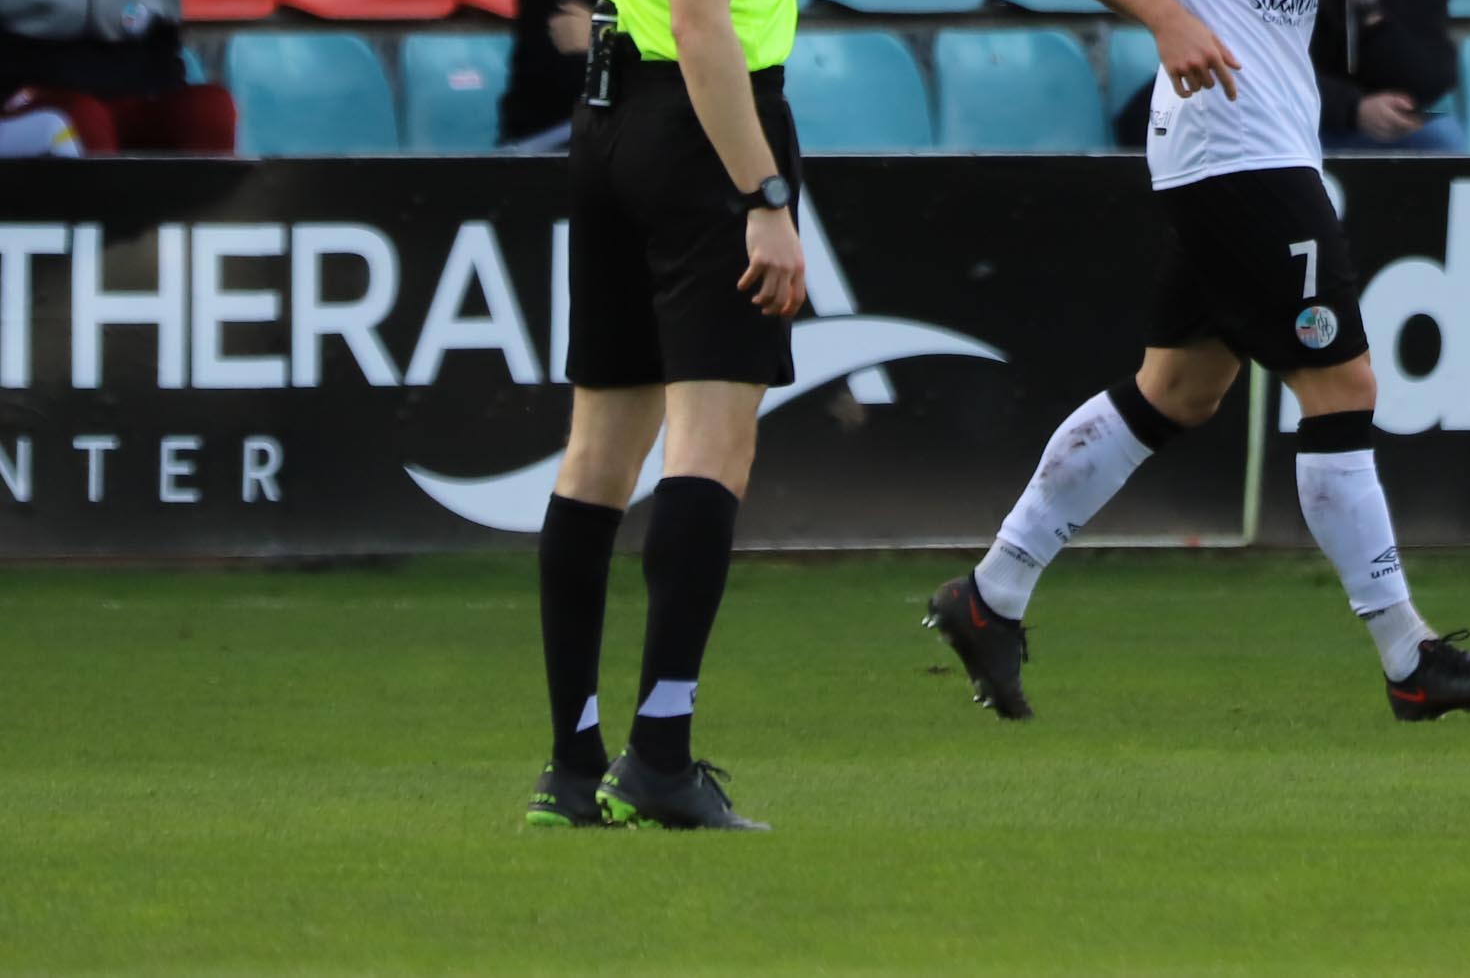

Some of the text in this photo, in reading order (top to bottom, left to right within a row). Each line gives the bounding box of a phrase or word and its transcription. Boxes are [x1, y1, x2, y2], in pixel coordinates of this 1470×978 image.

[1289, 239, 1317, 299] 7
[0, 219, 571, 389] THERA
[1371, 563, 1401, 579] umb
